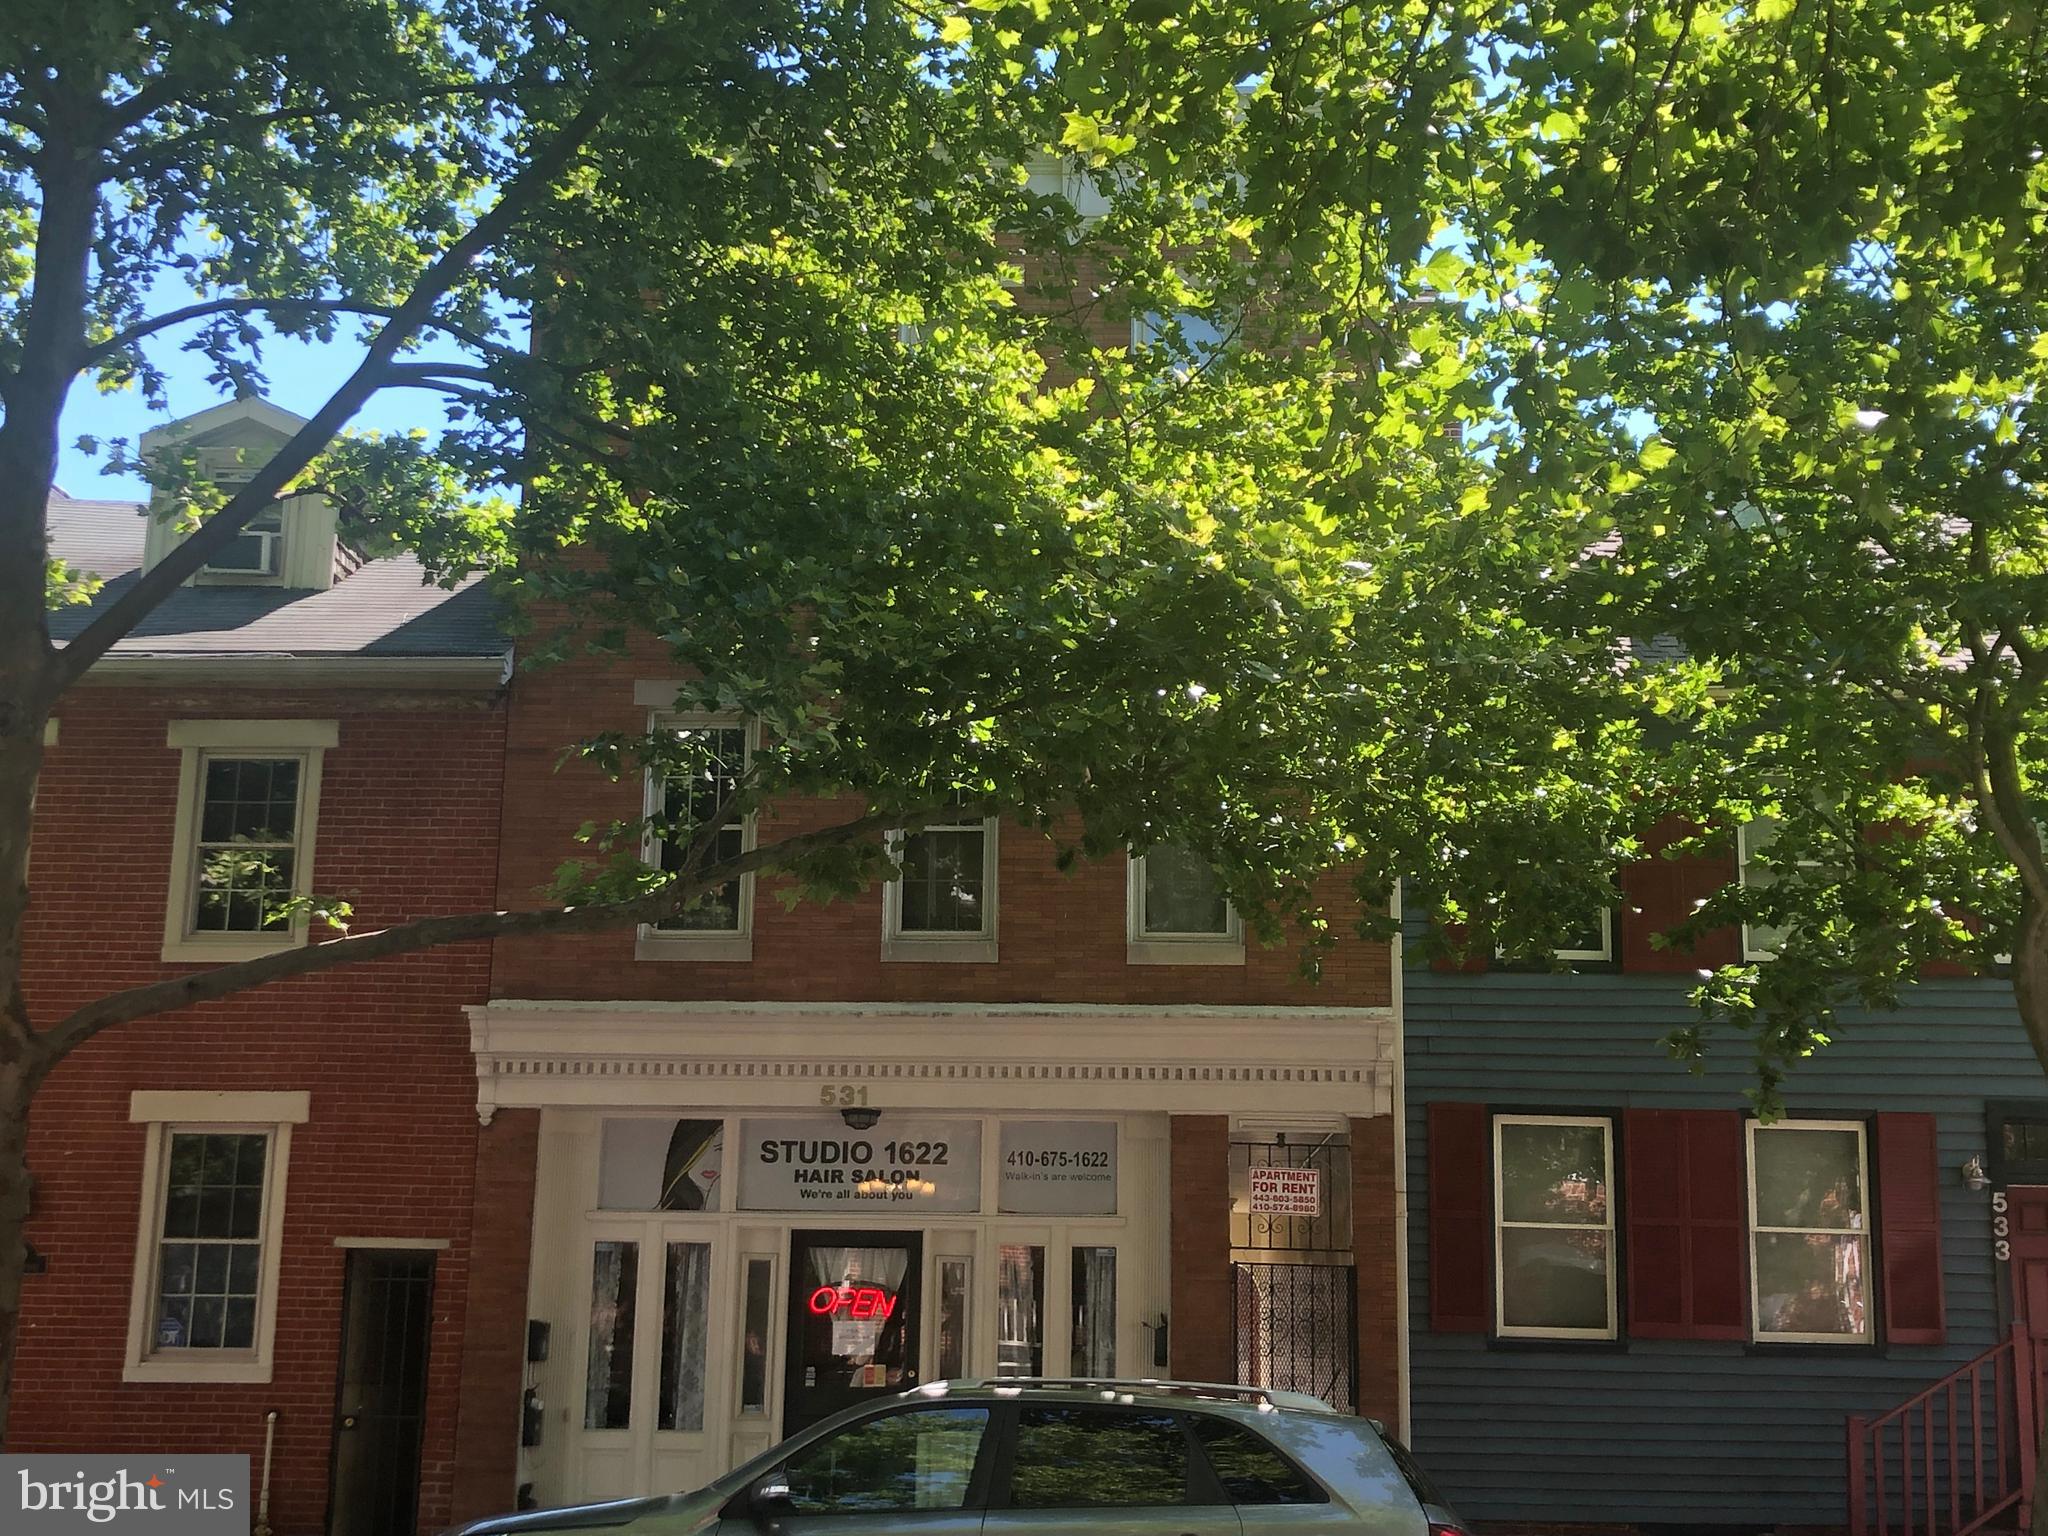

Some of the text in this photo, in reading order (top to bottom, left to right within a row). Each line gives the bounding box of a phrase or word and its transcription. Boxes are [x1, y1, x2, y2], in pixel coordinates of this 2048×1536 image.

[820, 1084, 868, 1106] 531
[760, 1140, 949, 1165] STUDIO 1622
[1007, 1150, 1109, 1168] 410-675-1622
[794, 1169, 920, 1185] HAIR SALON
[1070, 1173, 1112, 1182] welcome
[1252, 1170, 1317, 1182] APARTMENT
[800, 1189, 913, 1202] We're all about you
[1252, 1181, 1316, 1194] FOR RENT
[1992, 1192, 2011, 1261] 533
[809, 1286, 897, 1319] OPEN
